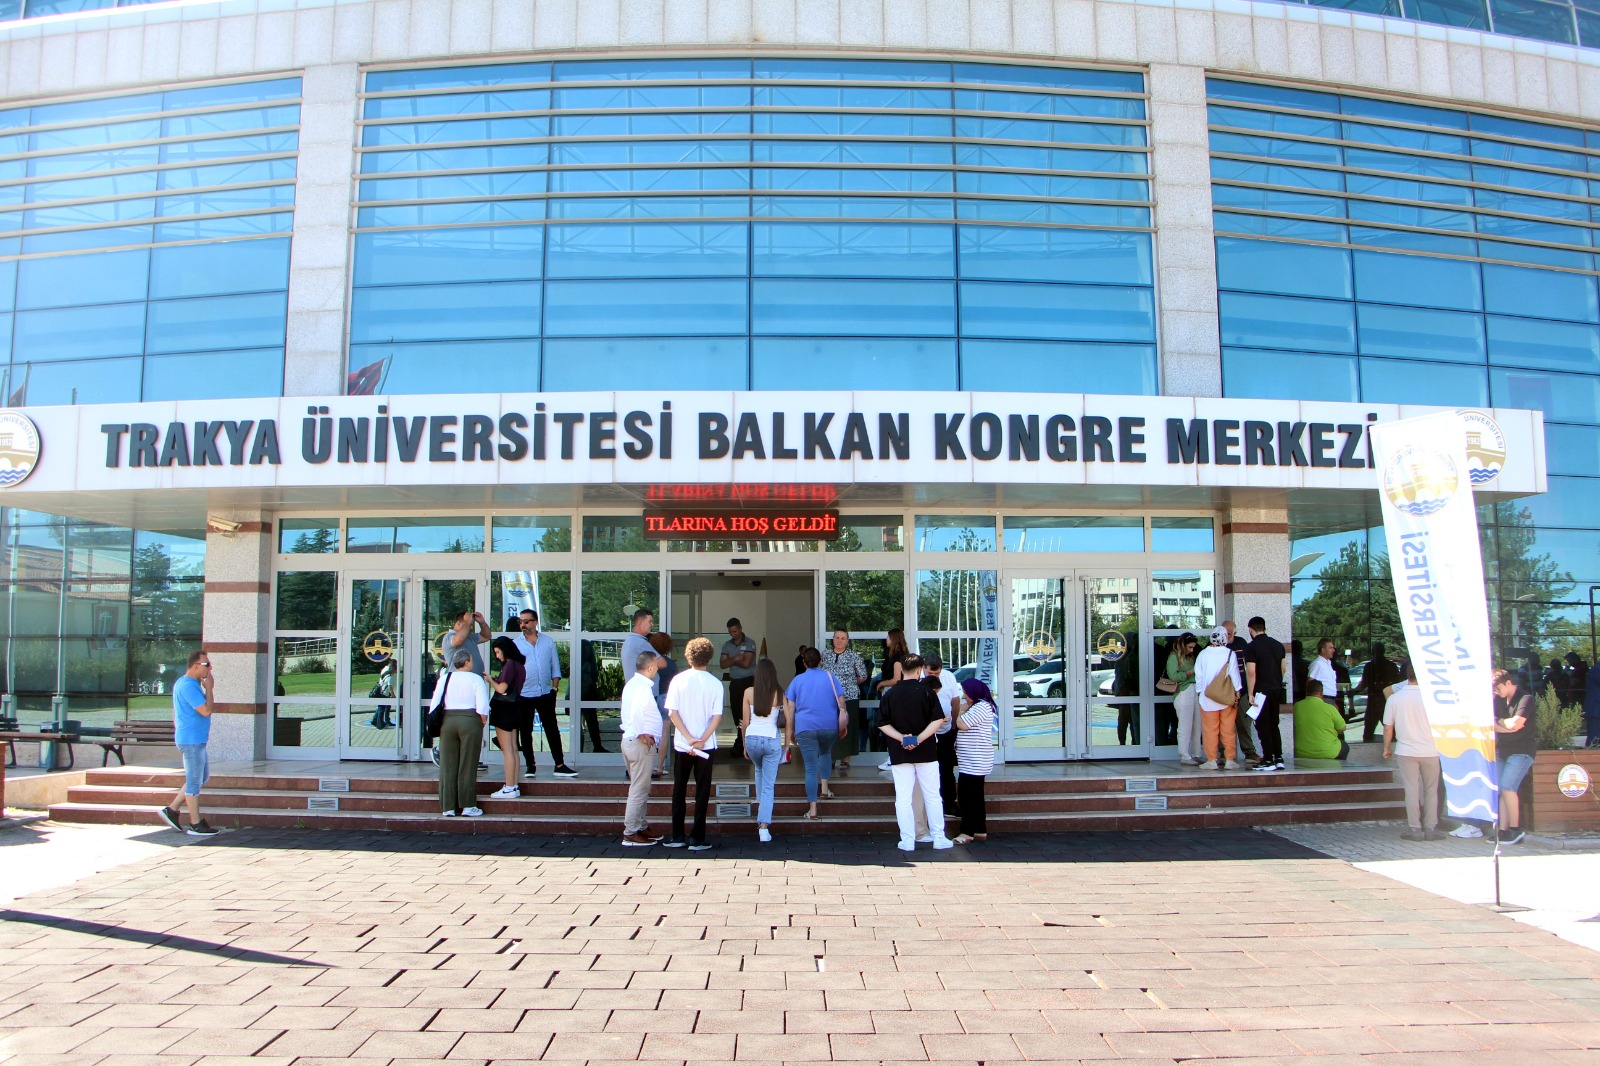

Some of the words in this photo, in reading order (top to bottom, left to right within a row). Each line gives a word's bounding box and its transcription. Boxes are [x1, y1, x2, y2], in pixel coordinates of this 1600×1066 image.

[101, 419, 282, 468] TRAKYA
[302, 401, 673, 463] ÜNİVERSİTESİ
[698, 412, 910, 460] BALKAN
[935, 413, 1147, 463] KONGRE
[1166, 412, 1378, 469] MERKEZİ
[646, 517, 728, 531] TLARINA
[731, 517, 769, 534] HOŞ
